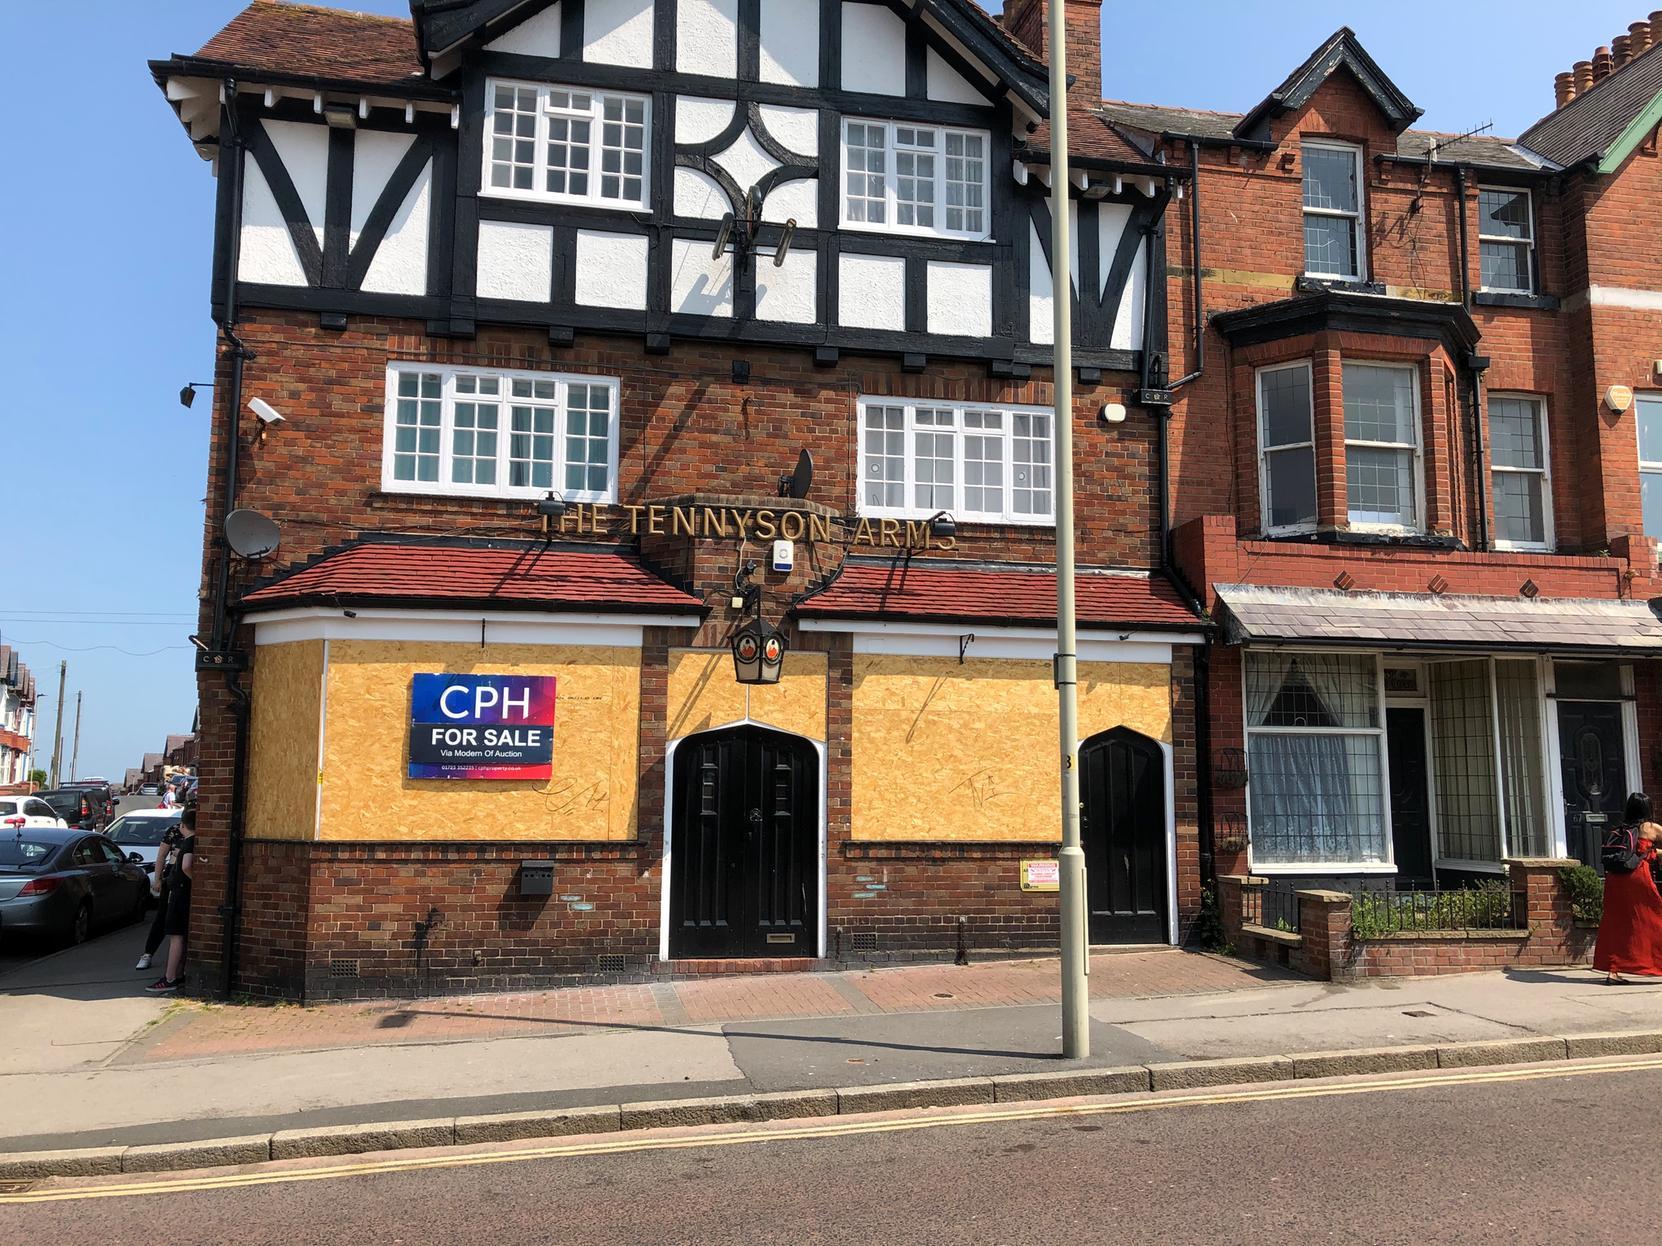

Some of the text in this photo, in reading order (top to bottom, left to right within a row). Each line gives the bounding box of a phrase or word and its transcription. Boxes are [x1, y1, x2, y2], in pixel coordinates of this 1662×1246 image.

[622, 505, 831, 542] TENNYSON
[439, 685, 530, 719] CPH
[431, 728, 541, 747] FOR SALE
[440, 749, 523, 758] Via Modern Of Auction
